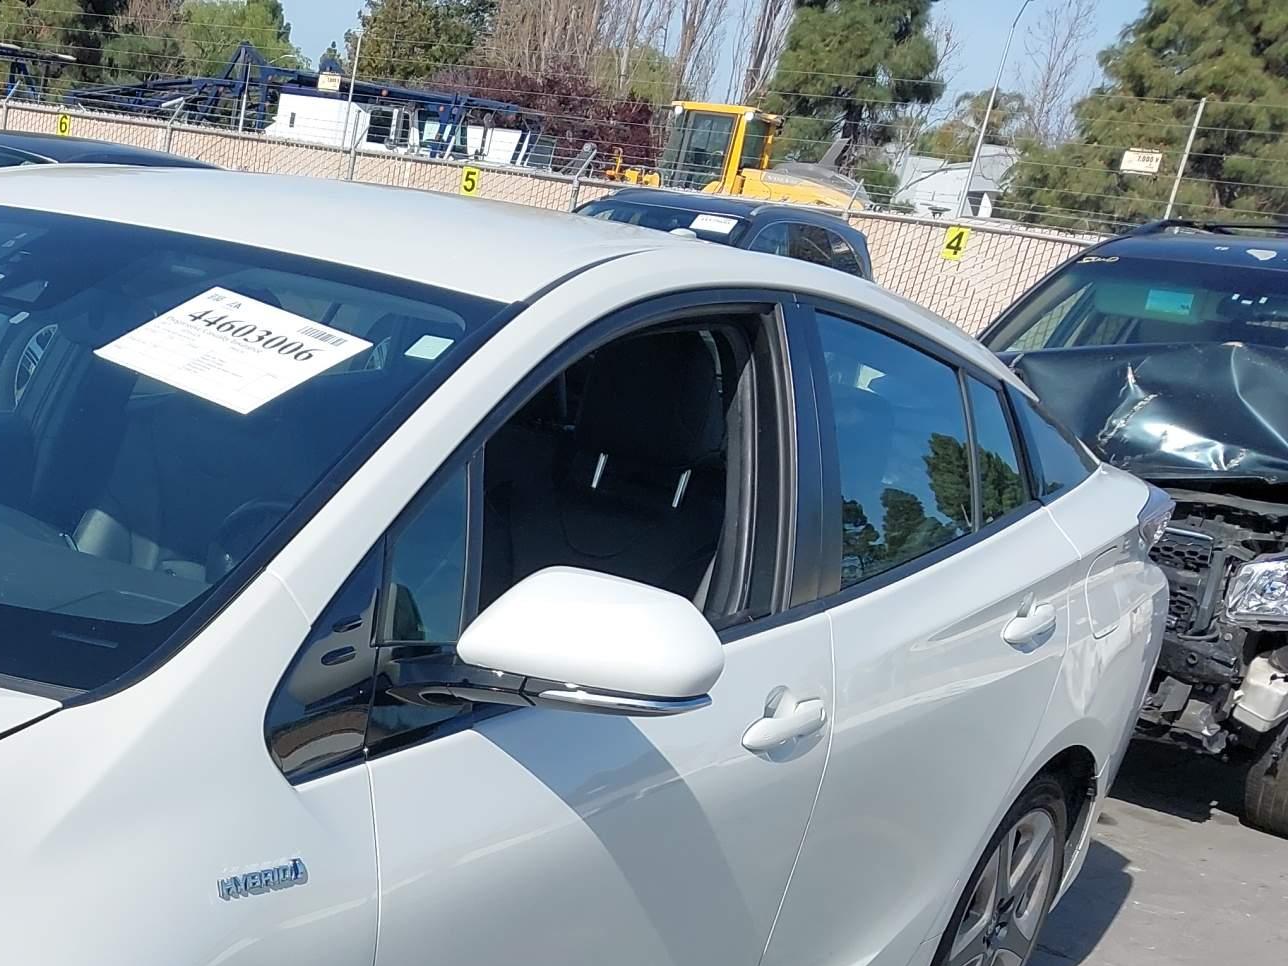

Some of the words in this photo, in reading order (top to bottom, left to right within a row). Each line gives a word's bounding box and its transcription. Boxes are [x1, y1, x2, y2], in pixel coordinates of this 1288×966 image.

[59, 115, 68, 133] 6
[463, 171, 476, 192] 5
[945, 231, 965, 255] 4
[188, 309, 324, 362] 44603006
[217, 864, 295, 901] HYBRID
